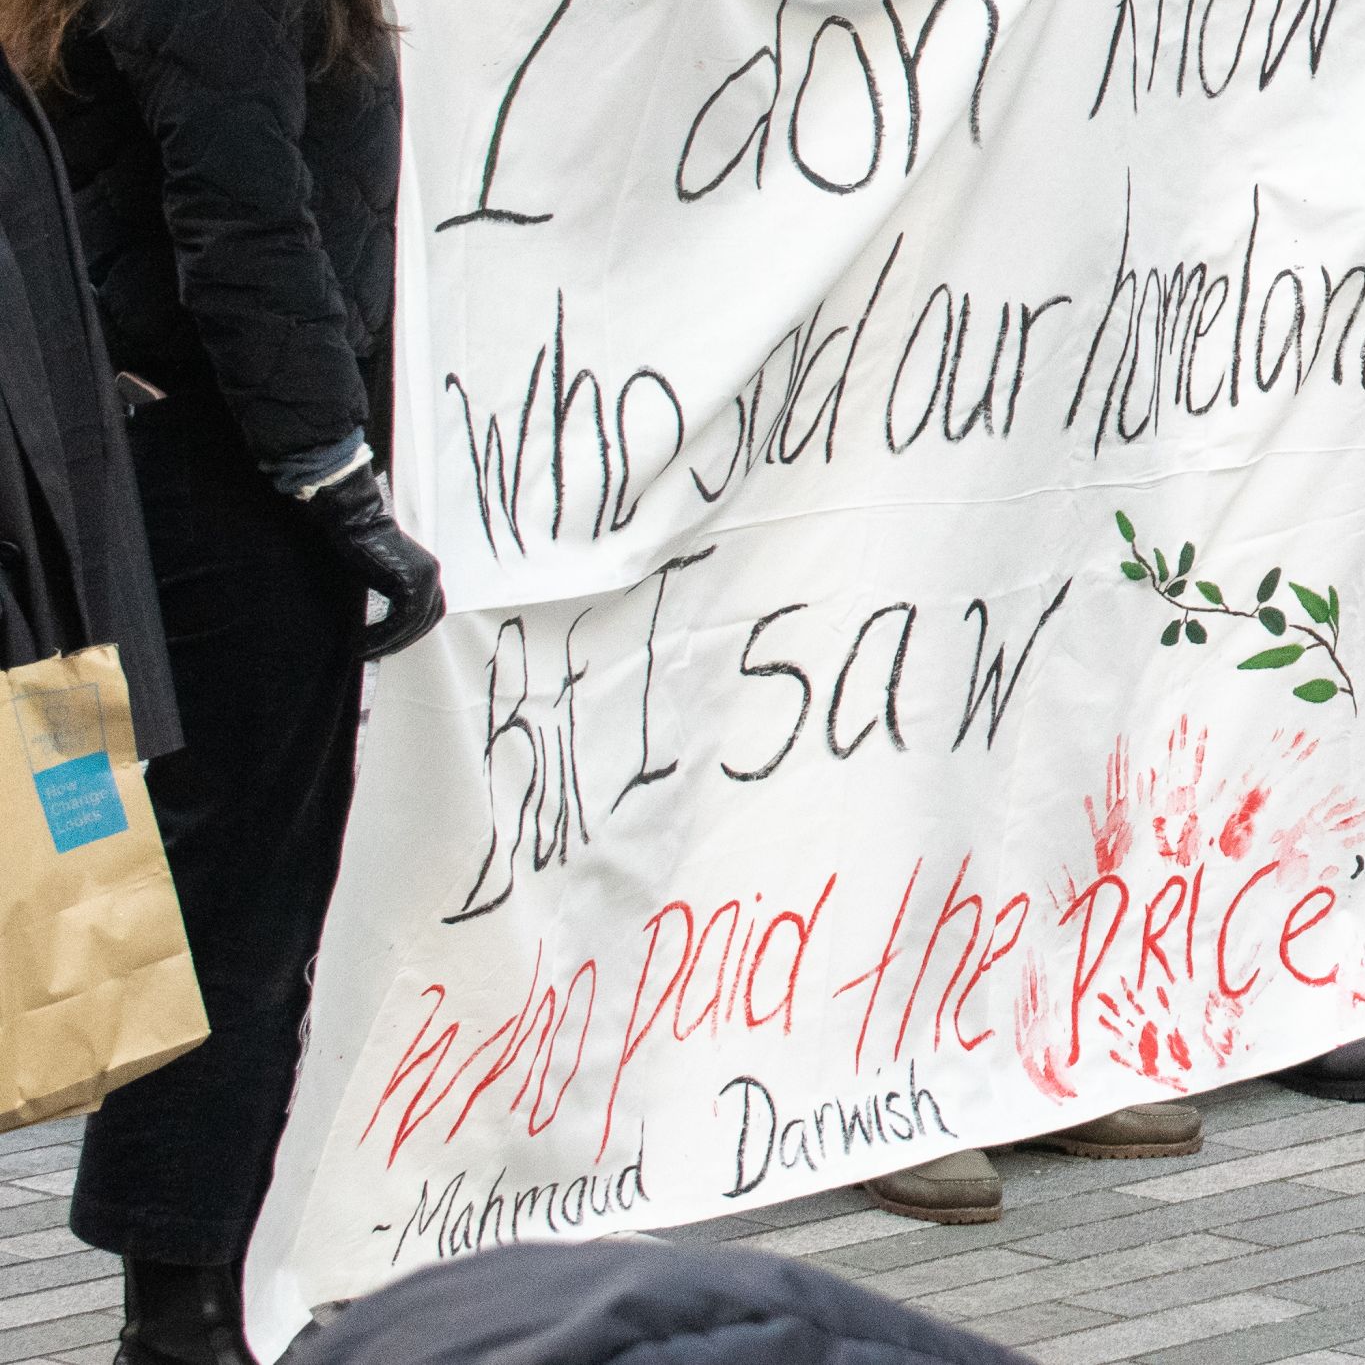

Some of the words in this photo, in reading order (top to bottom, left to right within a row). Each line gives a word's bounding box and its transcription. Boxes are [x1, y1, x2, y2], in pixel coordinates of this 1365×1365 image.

[886, 283, 1073, 455] our
[612, 544, 718, 815] I
[595, 872, 838, 1166] paid
[832, 849, 1031, 1056] the
[718, 1058, 958, 1198] Darwish
